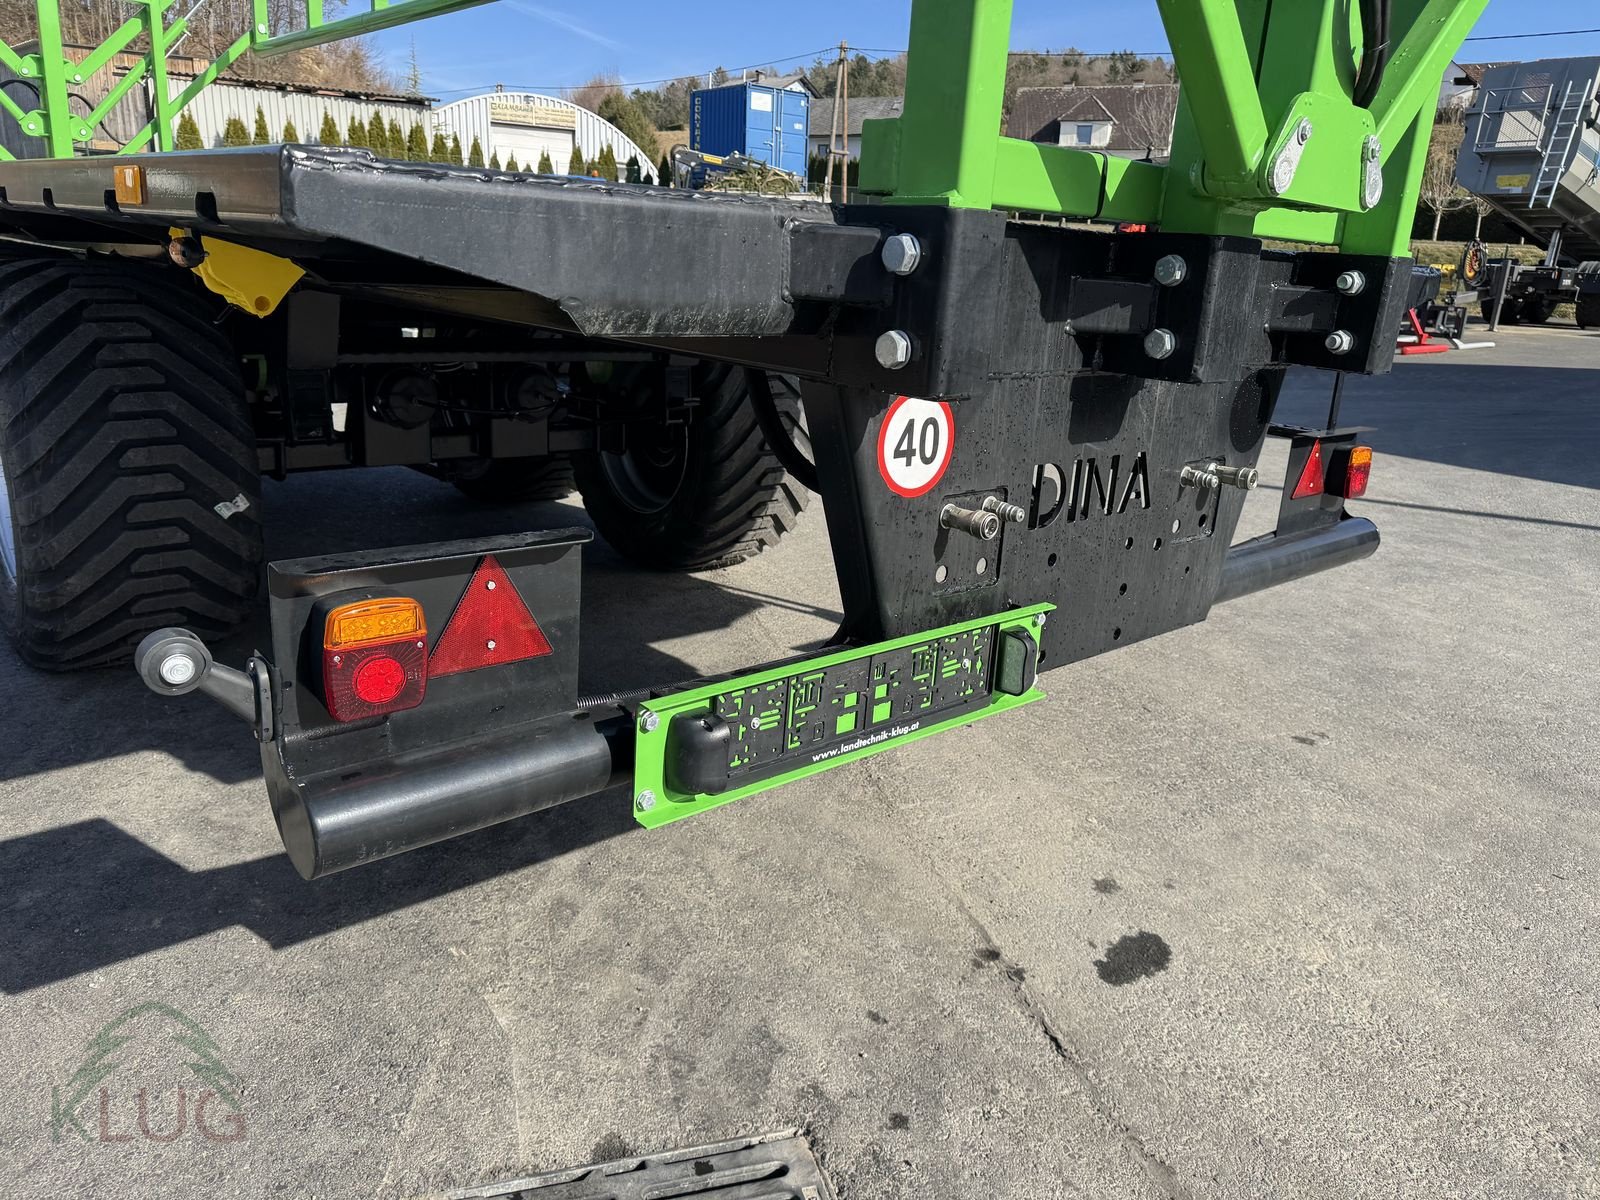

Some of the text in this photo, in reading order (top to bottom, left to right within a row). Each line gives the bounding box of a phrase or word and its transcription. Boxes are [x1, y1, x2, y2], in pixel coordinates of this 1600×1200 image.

[893, 417, 941, 467] 40
[1027, 451, 1151, 531] DINA
[812, 721, 920, 762] www.landtechnik-klug.at
